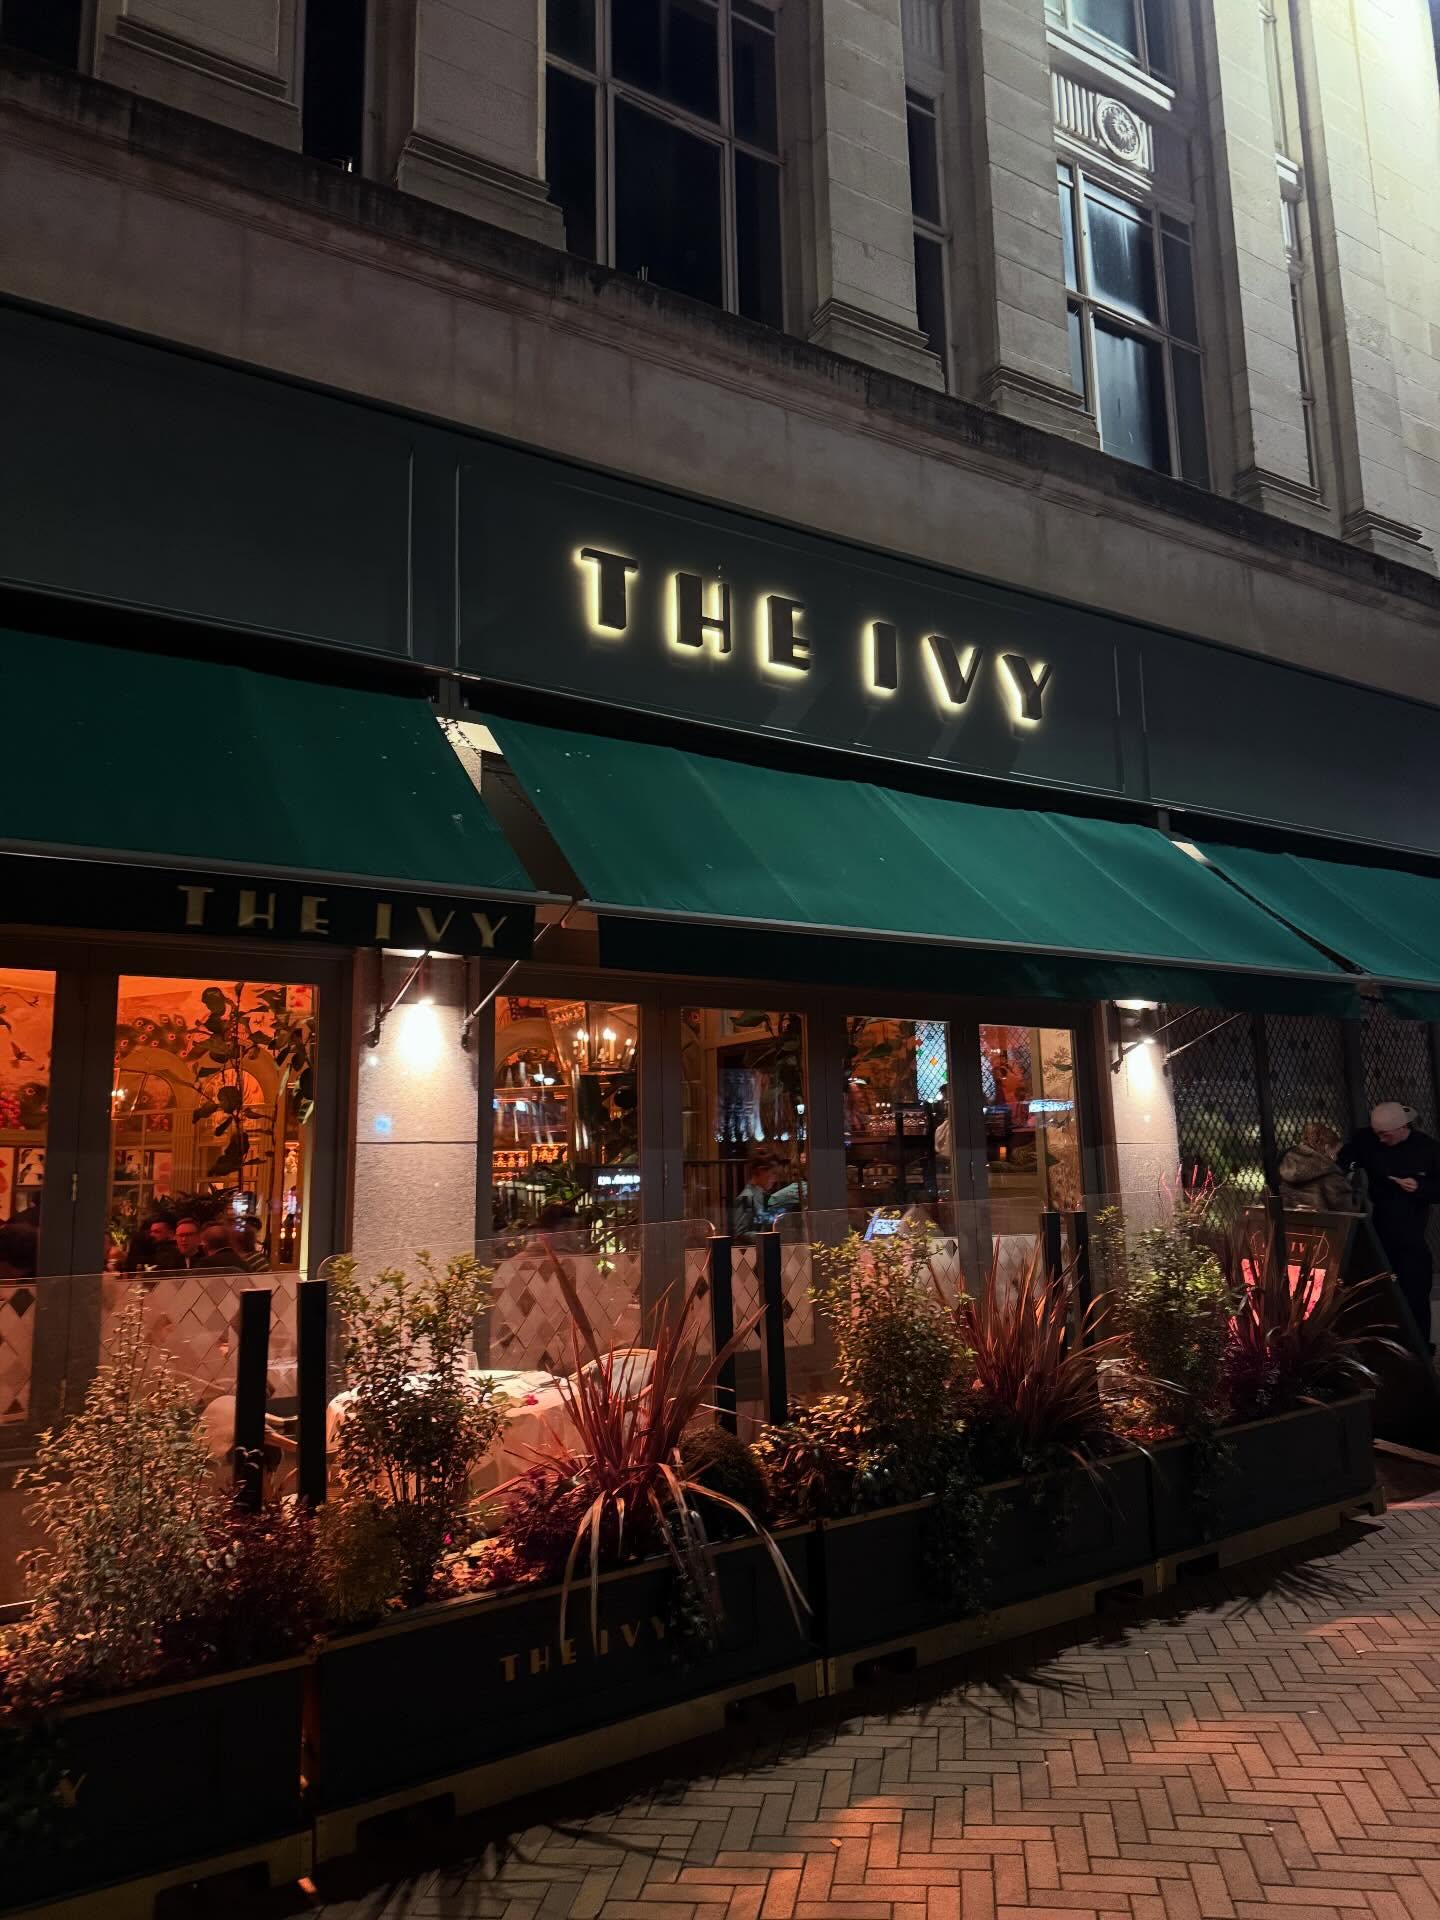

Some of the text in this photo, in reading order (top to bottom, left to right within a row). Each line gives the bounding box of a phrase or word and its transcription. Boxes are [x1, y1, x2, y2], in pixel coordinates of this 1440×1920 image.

[579, 546, 1054, 722] THE IVY
[177, 883, 512, 950] THE IVY
[499, 1637, 577, 1682] THE
